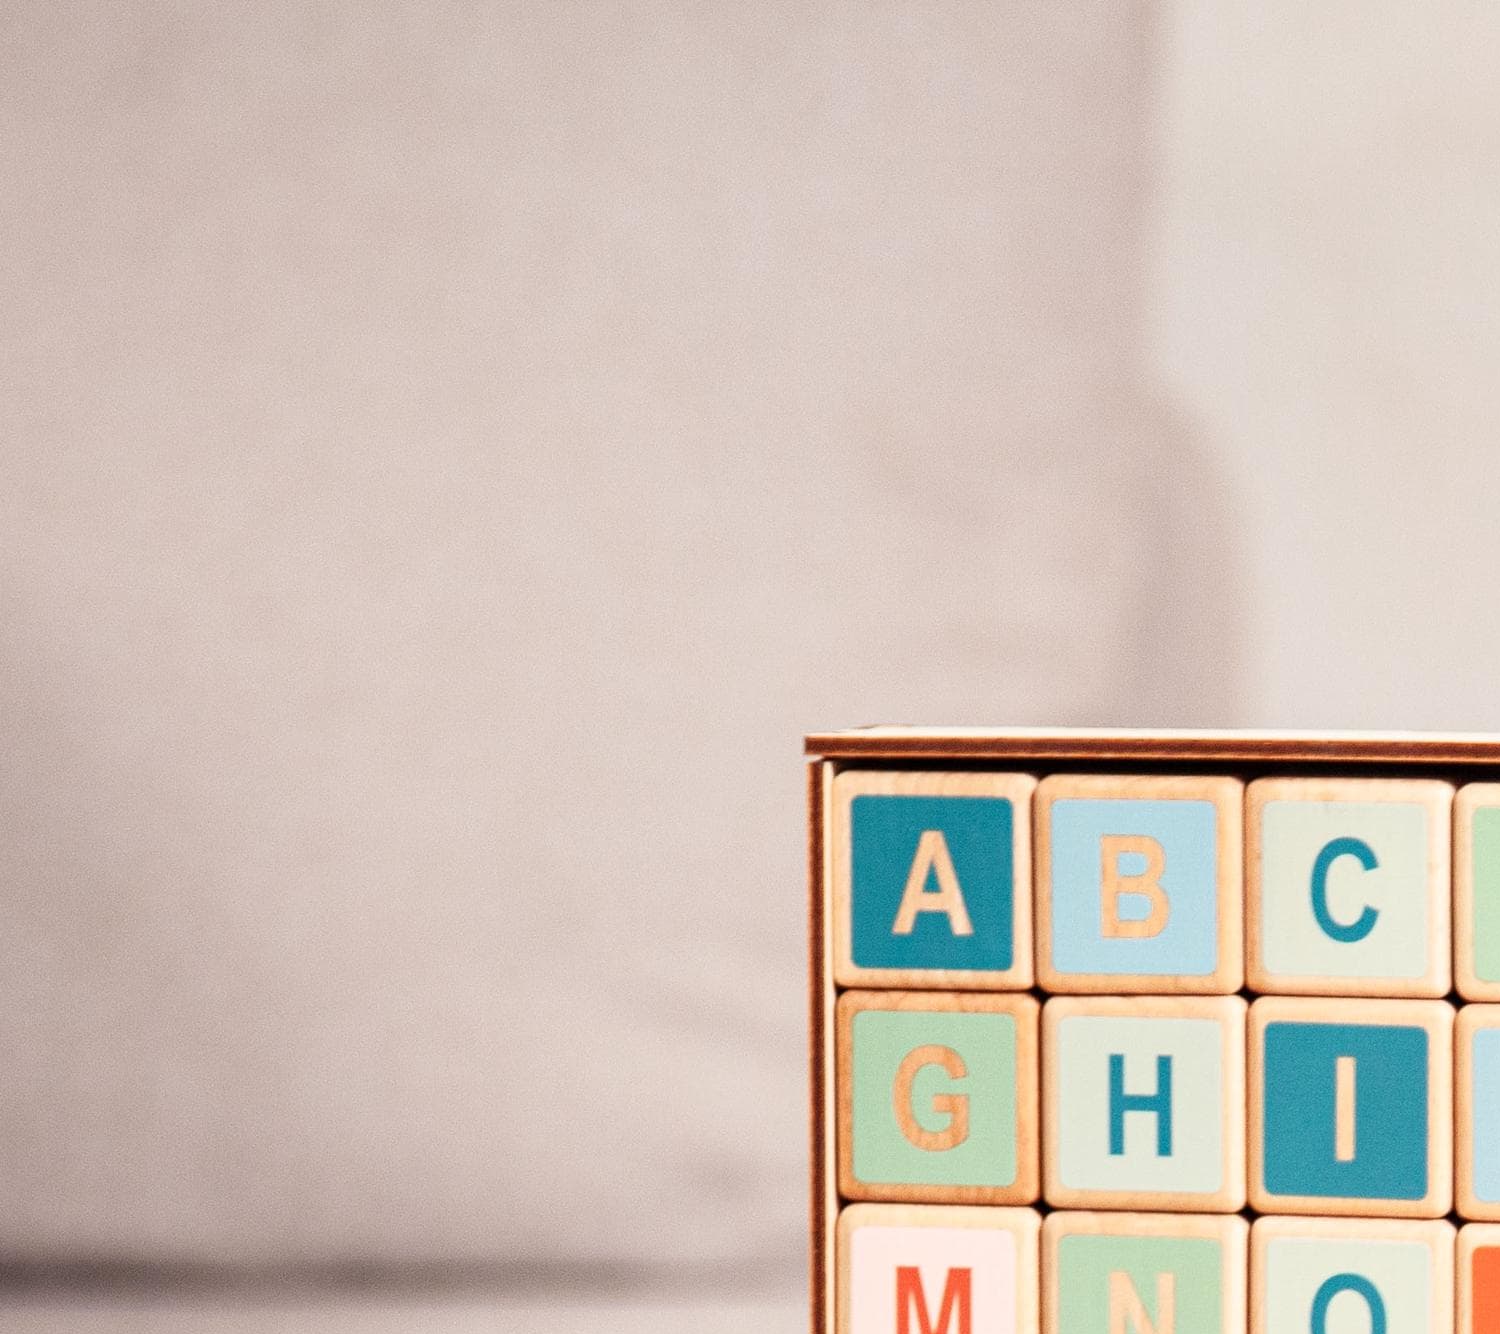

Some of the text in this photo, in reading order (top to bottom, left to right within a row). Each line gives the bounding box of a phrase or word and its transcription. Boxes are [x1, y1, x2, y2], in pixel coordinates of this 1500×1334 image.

[892, 830, 973, 936] A
[1100, 834, 1170, 939] B
[1310, 836, 1379, 944] C
[892, 1044, 969, 1152] G
[1108, 1053, 1173, 1158] H
[1335, 1056, 1356, 1162] I
